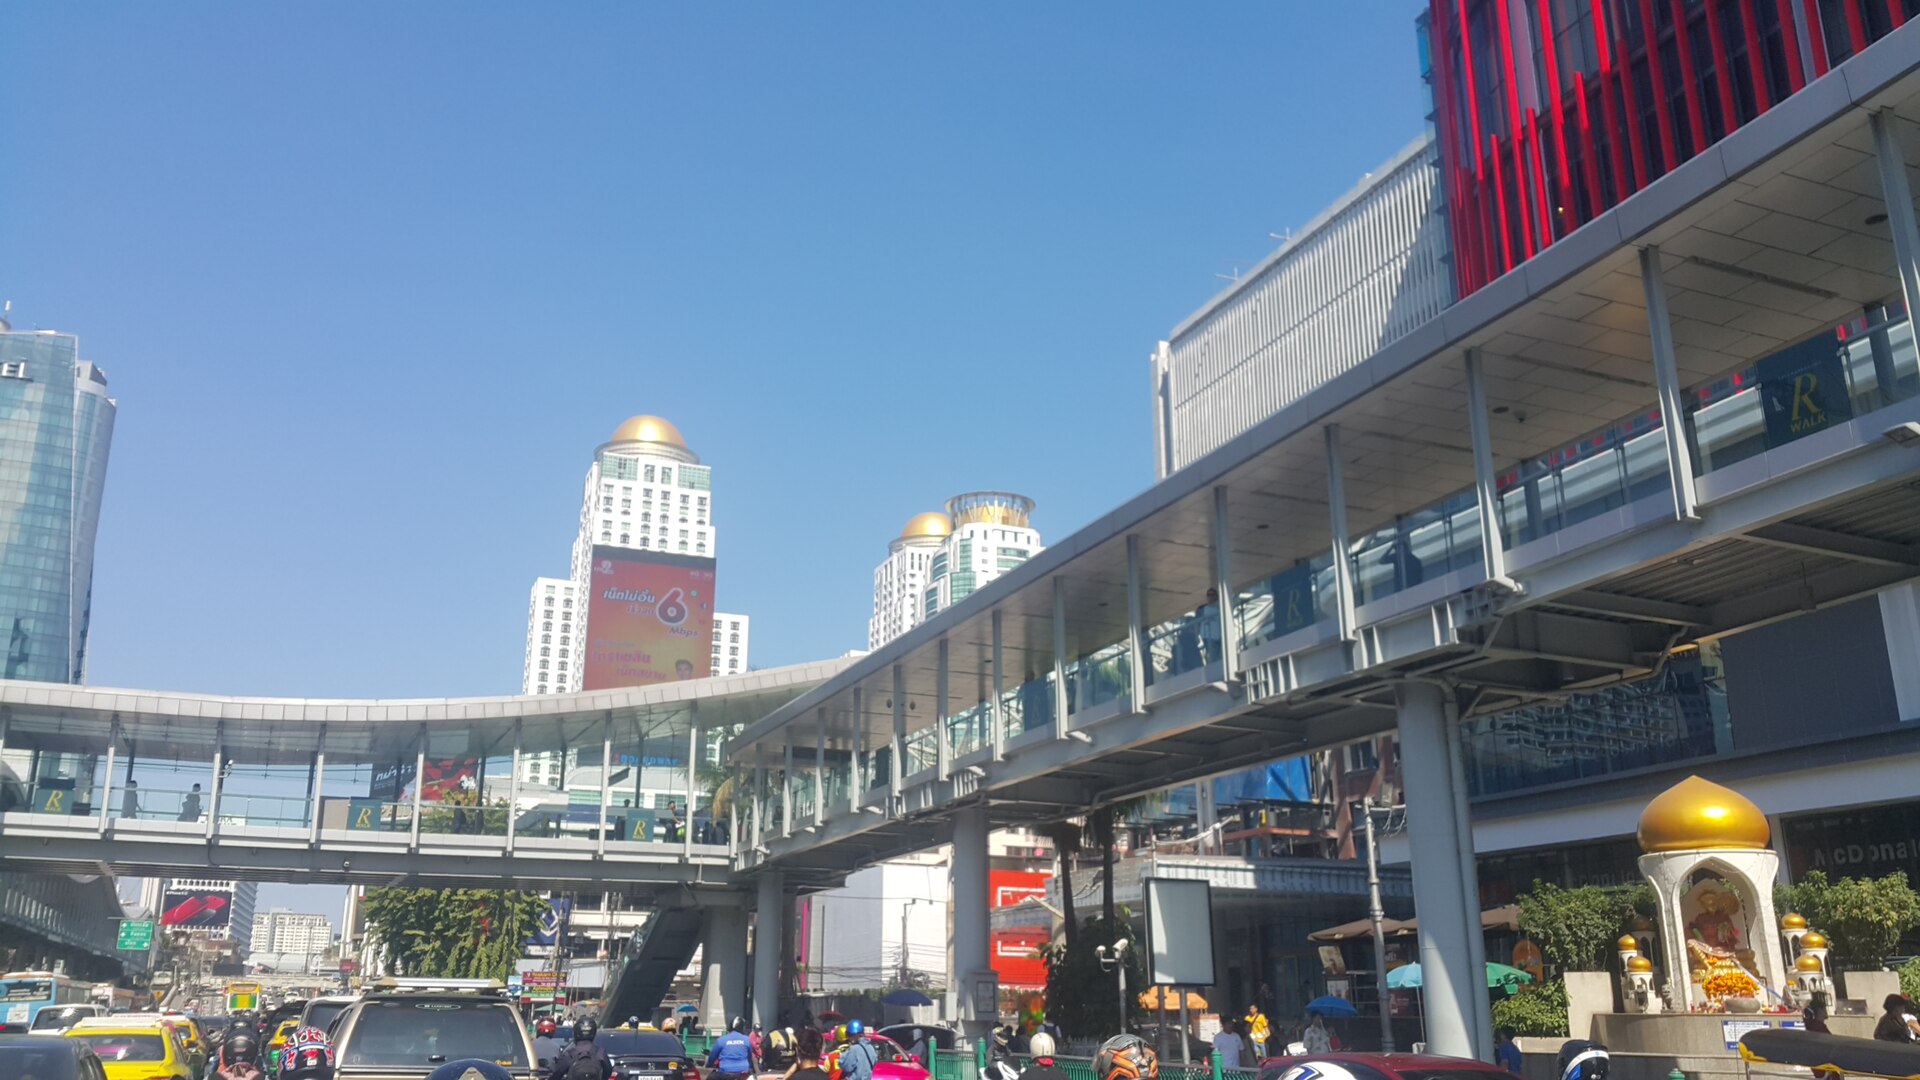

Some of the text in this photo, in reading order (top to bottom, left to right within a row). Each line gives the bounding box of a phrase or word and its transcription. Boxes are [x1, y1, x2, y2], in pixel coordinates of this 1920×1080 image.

[1792, 373, 1817, 419] R
[1791, 411, 1826, 433] WALK
[656, 587, 688, 625] 6
[46, 790, 63, 809] R
[1814, 838, 1920, 866] McDonal
